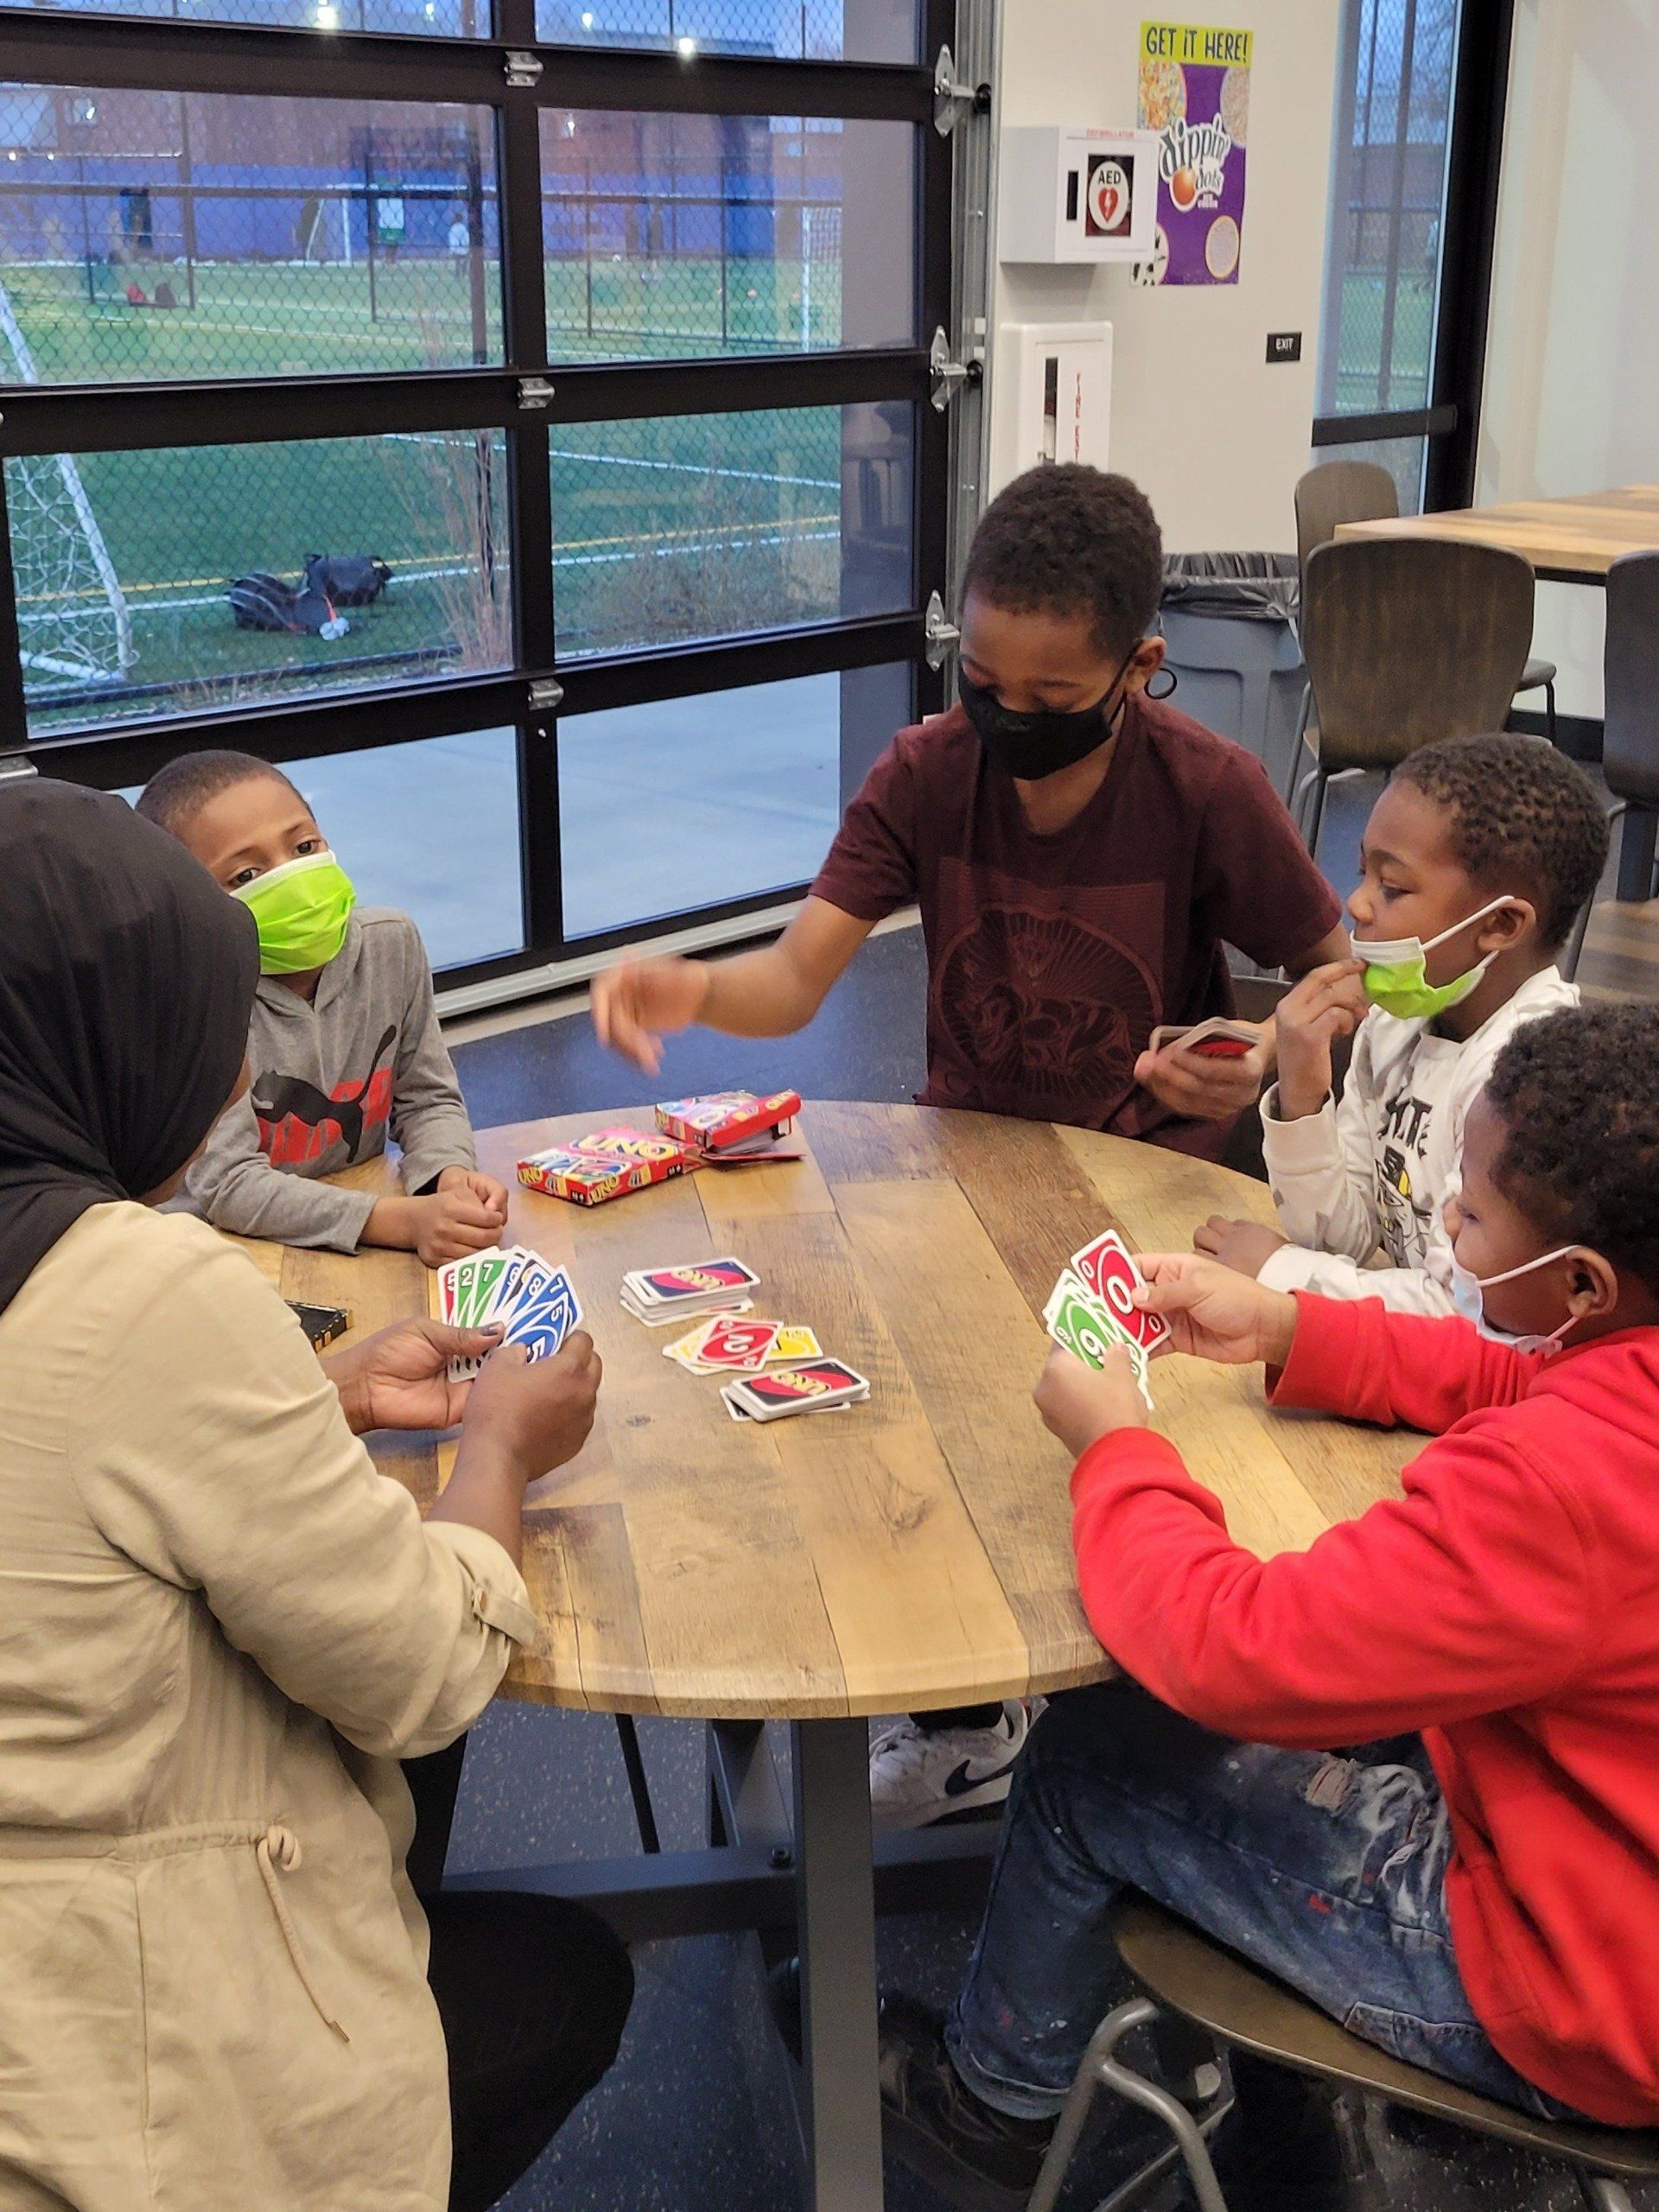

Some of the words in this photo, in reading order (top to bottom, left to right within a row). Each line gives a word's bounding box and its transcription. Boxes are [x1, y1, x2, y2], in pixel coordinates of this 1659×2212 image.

[1146, 26, 1176, 57] GET
[1183, 29, 1198, 59] IT
[1205, 30, 1249, 63] HERE!
[1097, 170, 1122, 185] AED
[1275, 337, 1294, 353] EXIT
[569, 1134, 680, 1160] UNO
[518, 1167, 543, 1187] UNO
[589, 1176, 620, 1205] UNO
[461, 1268, 473, 1287] 2
[483, 1263, 494, 1283] 7
[670, 1269, 726, 1291] UNO
[528, 1277, 542, 1296] 8
[550, 1276, 563, 1294] 7
[550, 1305, 563, 1322] 5
[527, 1336, 546, 1364] 5
[722, 1334, 755, 1354] 2
[769, 1371, 831, 1396] UNO
